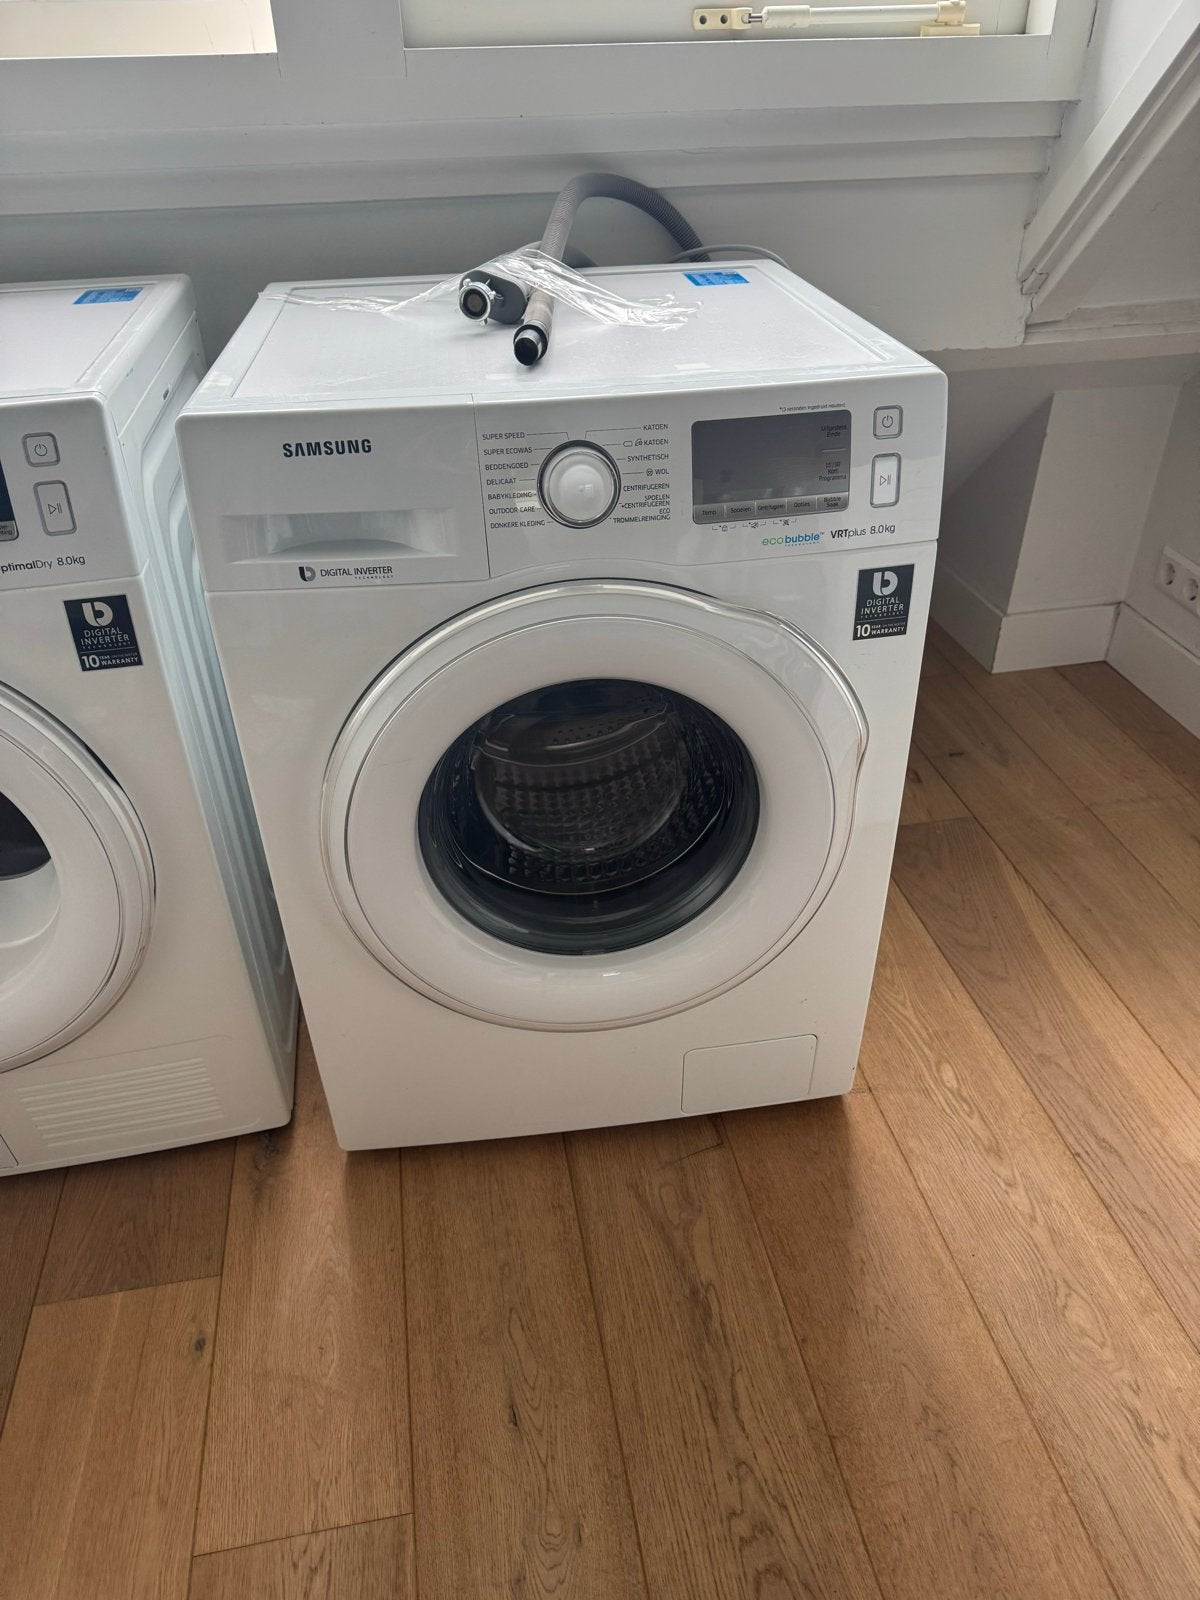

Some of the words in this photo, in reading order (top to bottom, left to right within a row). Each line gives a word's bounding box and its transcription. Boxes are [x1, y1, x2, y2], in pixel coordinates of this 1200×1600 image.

[282, 439, 372, 457] SAMSUNG
[627, 454, 669, 462] SYNTHETISCH
[485, 462, 529, 470] BEDDENGOED
[486, 478, 516, 486] DELICAAT
[623, 483, 670, 491] CENTRIFUGEREN
[488, 492, 532, 500] BABYKLEDING
[489, 507, 518, 515] OUTDOOR
[730, 506, 751, 514] Spoelen
[613, 514, 671, 523] TROMMELREINIGING
[490, 521, 518, 529] DONKERE
[830, 528, 866, 539] VRTplus
[870, 524, 896, 534] 8.0kg
[1, 560, 52, 573] ptimalDry
[57, 556, 85, 566] 8.0kg
[320, 568, 352, 577] DIGITAL
[354, 566, 393, 575] INVERTER
[866, 596, 900, 606] DIGITAL
[861, 604, 904, 614] INVERTER
[84, 627, 122, 637] DIGITAL
[856, 624, 870, 637] 10
[81, 634, 129, 645] INVERTER
[82, 655, 99, 668] 10
[101, 657, 138, 665] WARRANTY
